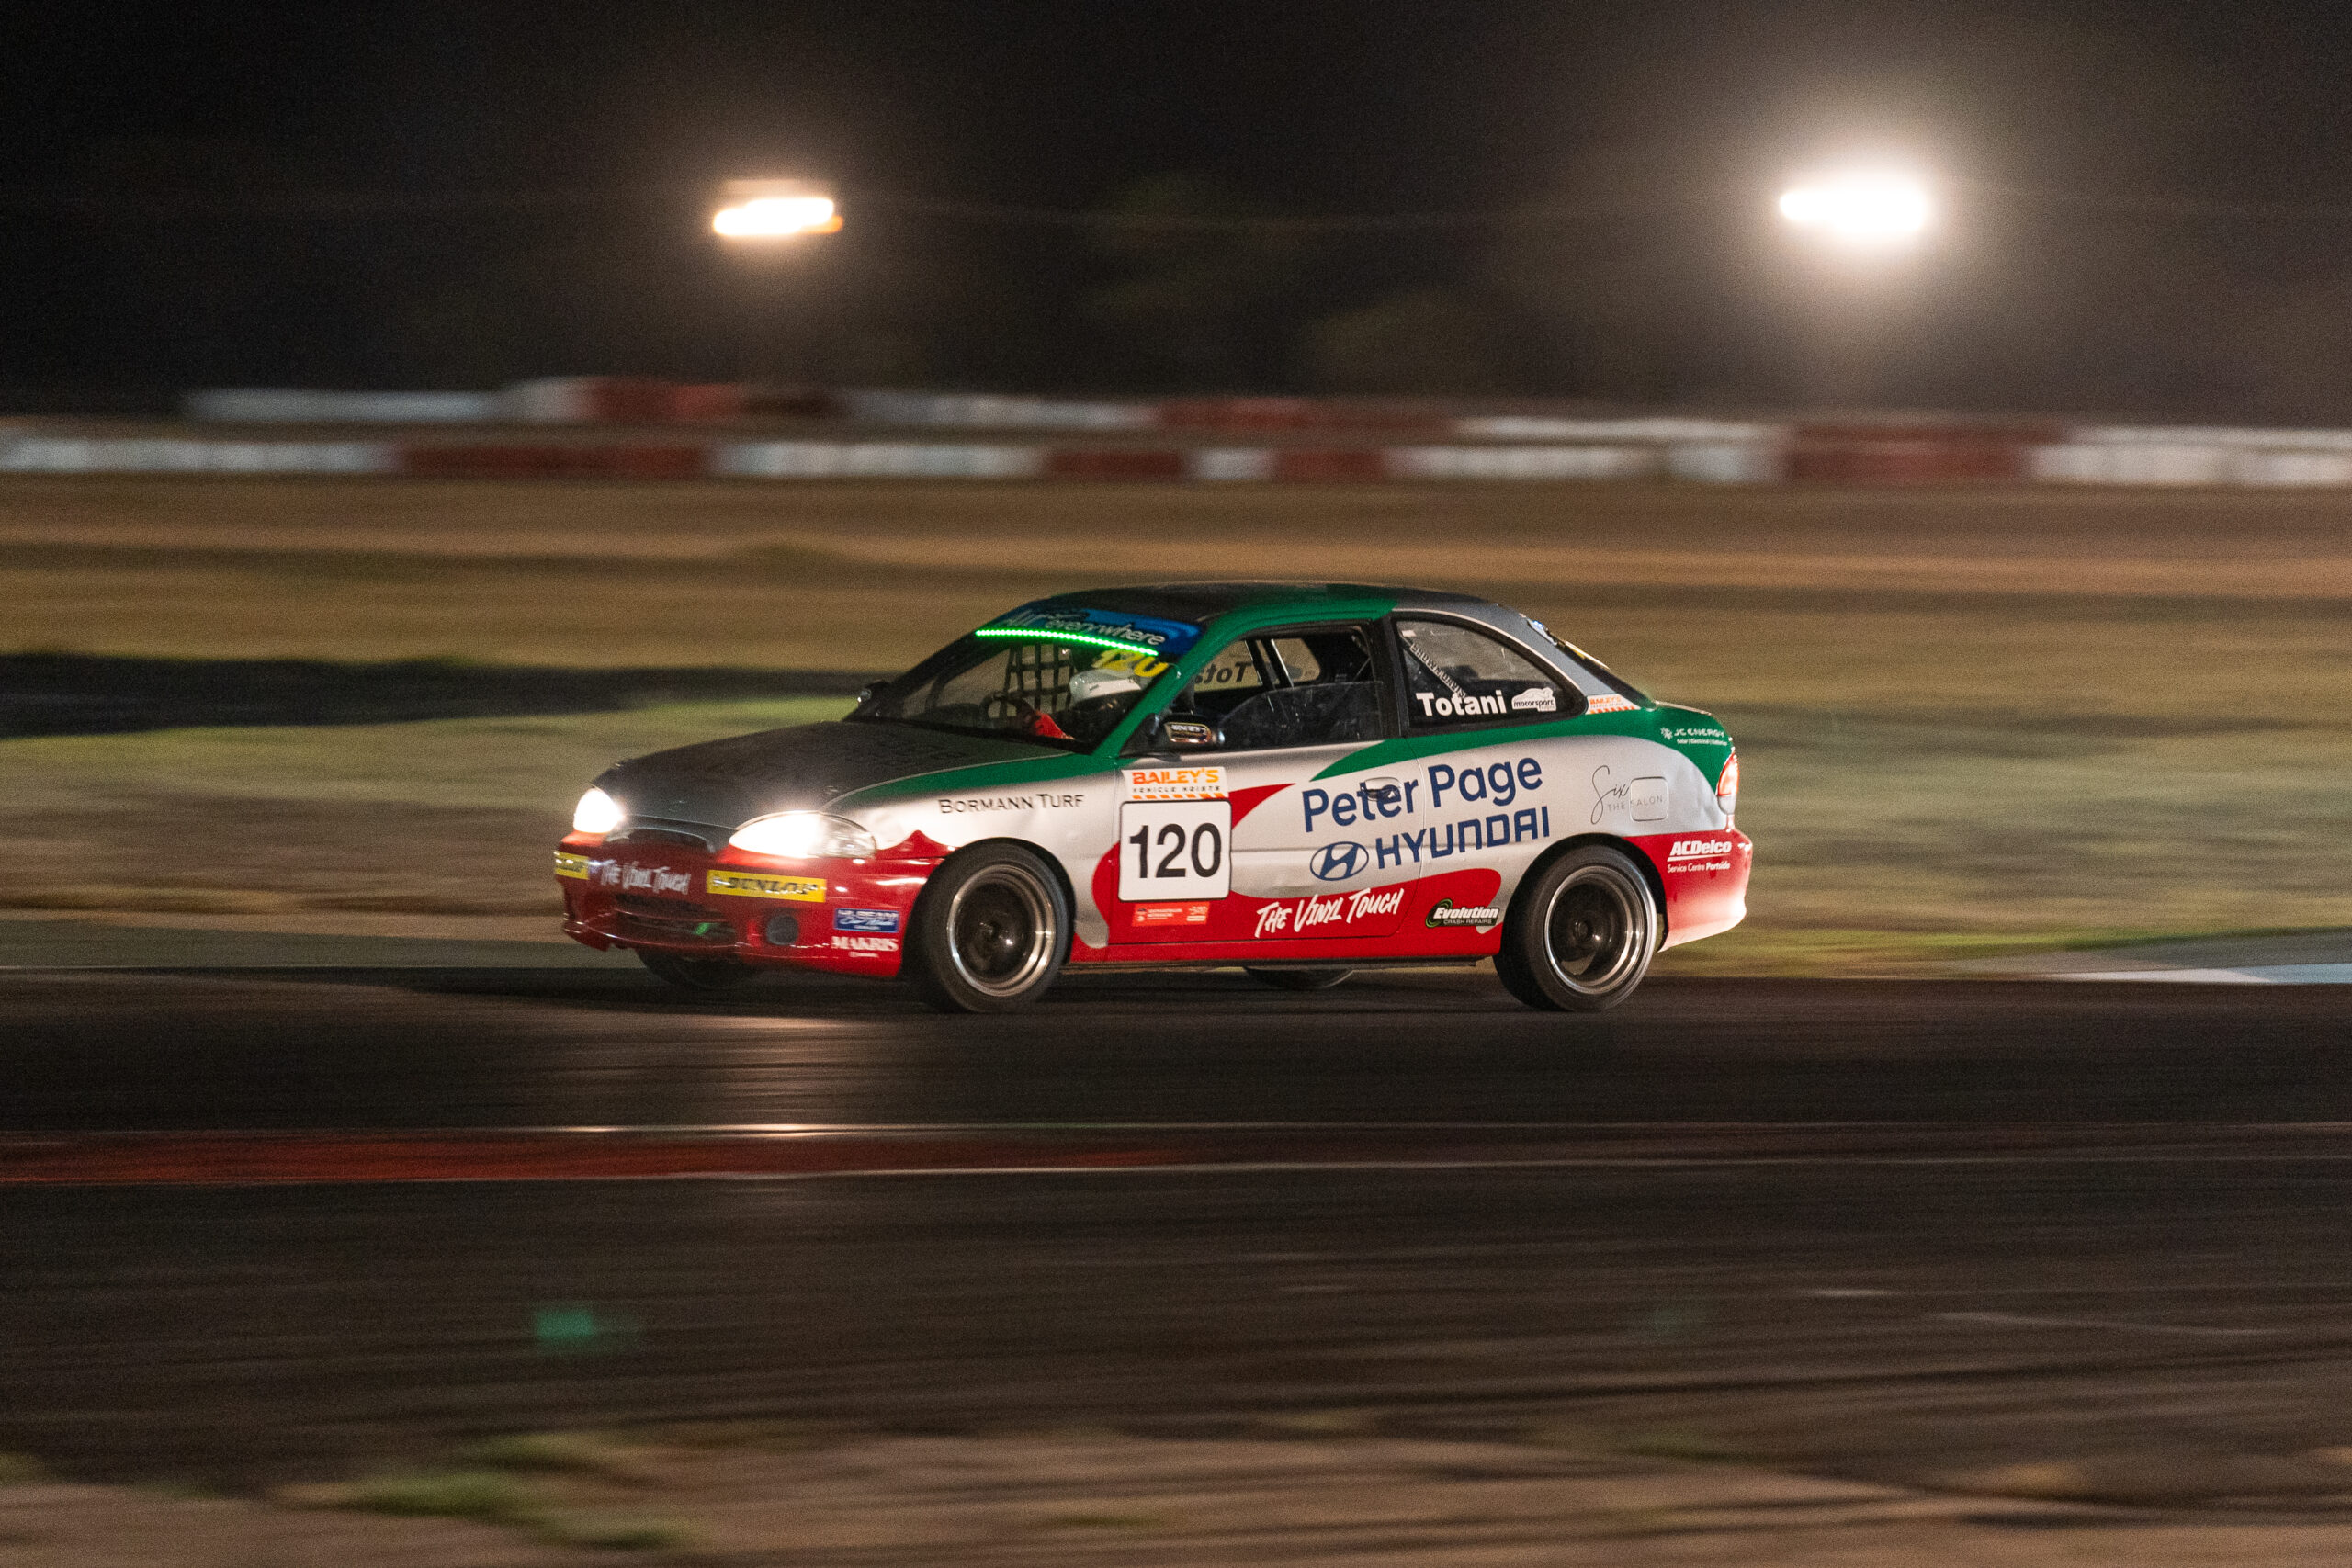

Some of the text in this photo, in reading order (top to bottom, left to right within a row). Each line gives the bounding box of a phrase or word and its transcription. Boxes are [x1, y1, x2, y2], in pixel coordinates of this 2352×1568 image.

[1416, 690, 1507, 716] Totani
[1513, 699, 1555, 707] motorsport
[1132, 767, 1219, 784] BAILEY'S
[938, 793, 1084, 814] BORMANN TURF
[1302, 757, 1543, 833] Peter Page
[1607, 795, 1663, 812] THE SALON
[1375, 806, 1550, 869] HYUNDAI
[1669, 839, 1733, 856] ACDelco
[1129, 822, 1222, 879] 120
[1254, 887, 1405, 938] THE VINYL TOUCH
[1433, 906, 1499, 919] Evolution
